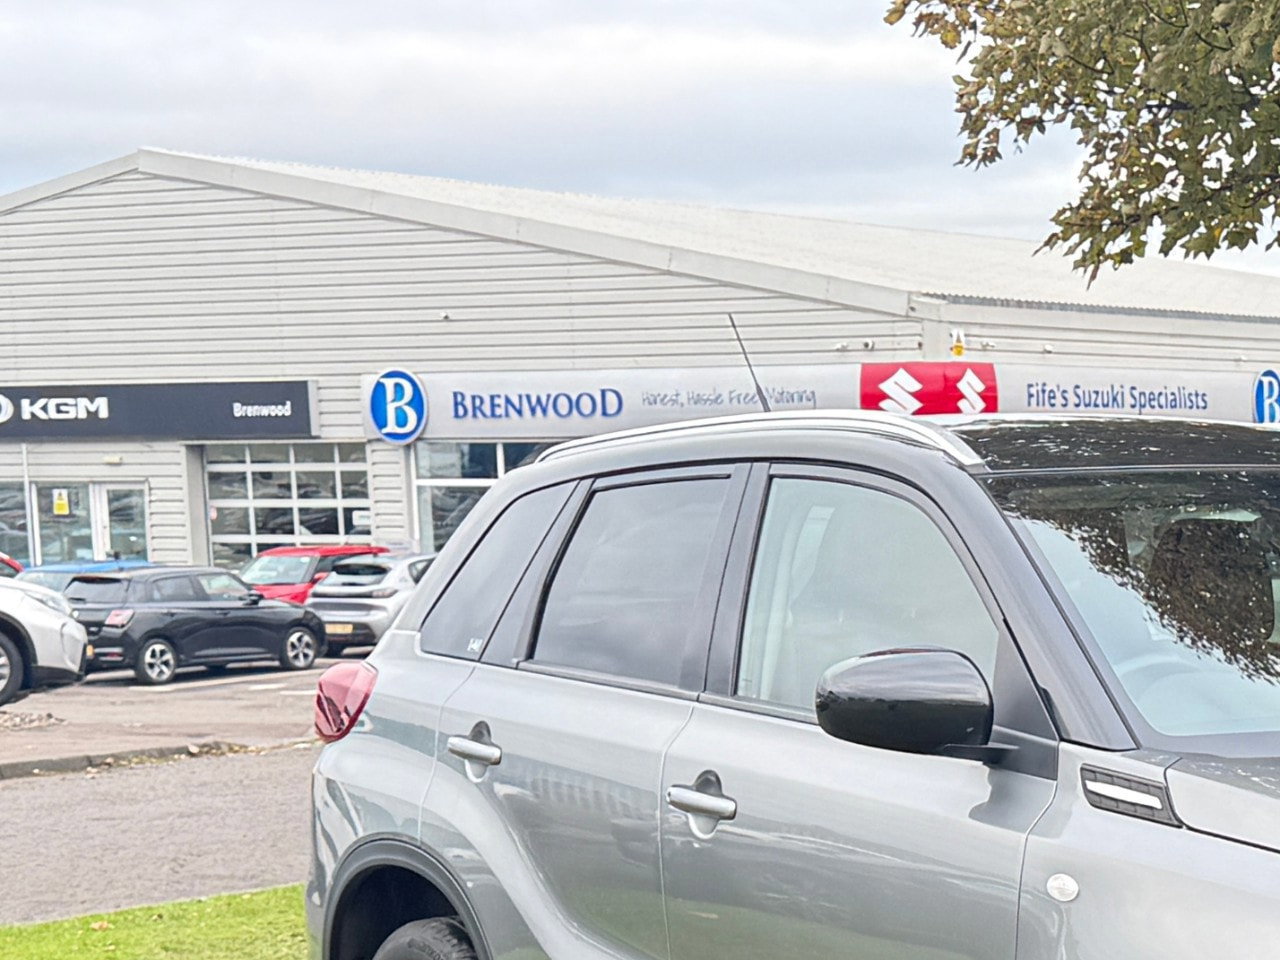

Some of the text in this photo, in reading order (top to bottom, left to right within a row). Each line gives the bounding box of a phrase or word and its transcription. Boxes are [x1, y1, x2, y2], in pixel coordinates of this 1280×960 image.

[21, 397, 109, 420] KGM
[233, 400, 291, 417] Brenwood
[379, 377, 417, 433] B
[452, 388, 624, 419] BRENWOOD
[687, 386, 724, 406] Hassle
[728, 389, 759, 405] Free
[1027, 382, 1208, 415] Fife's Suzuki Specialists
